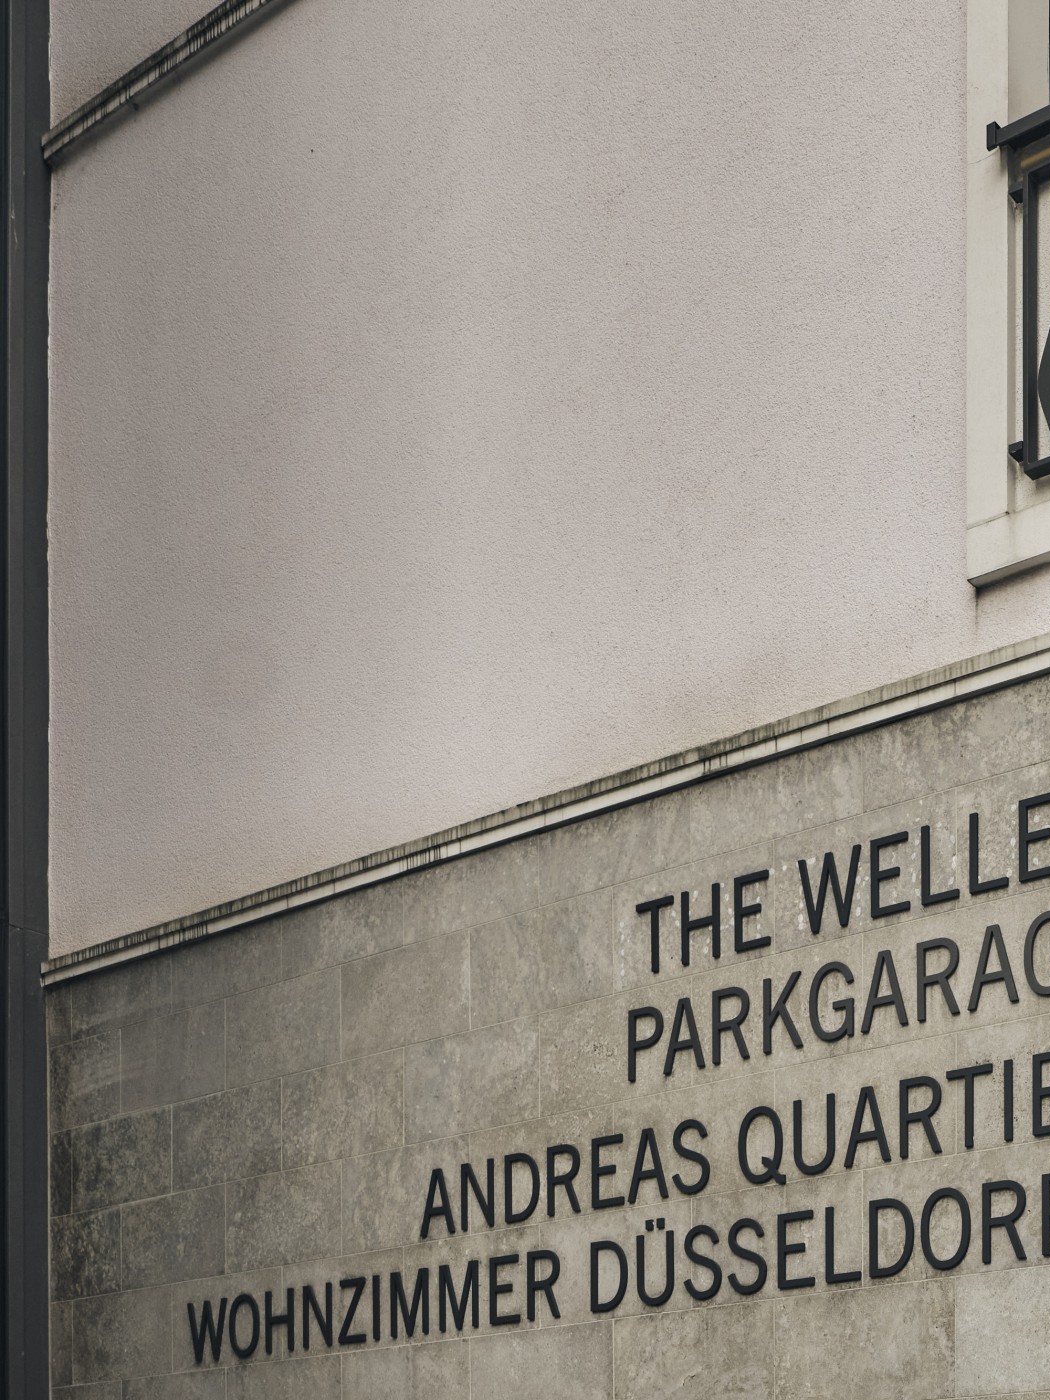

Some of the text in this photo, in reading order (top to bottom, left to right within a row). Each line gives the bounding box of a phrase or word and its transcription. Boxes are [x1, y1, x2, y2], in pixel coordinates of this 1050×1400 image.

[635, 869, 772, 974] THE
[421, 1119, 712, 1239] ANDREAS
[186, 1249, 562, 1366] WOHNZIMMER
